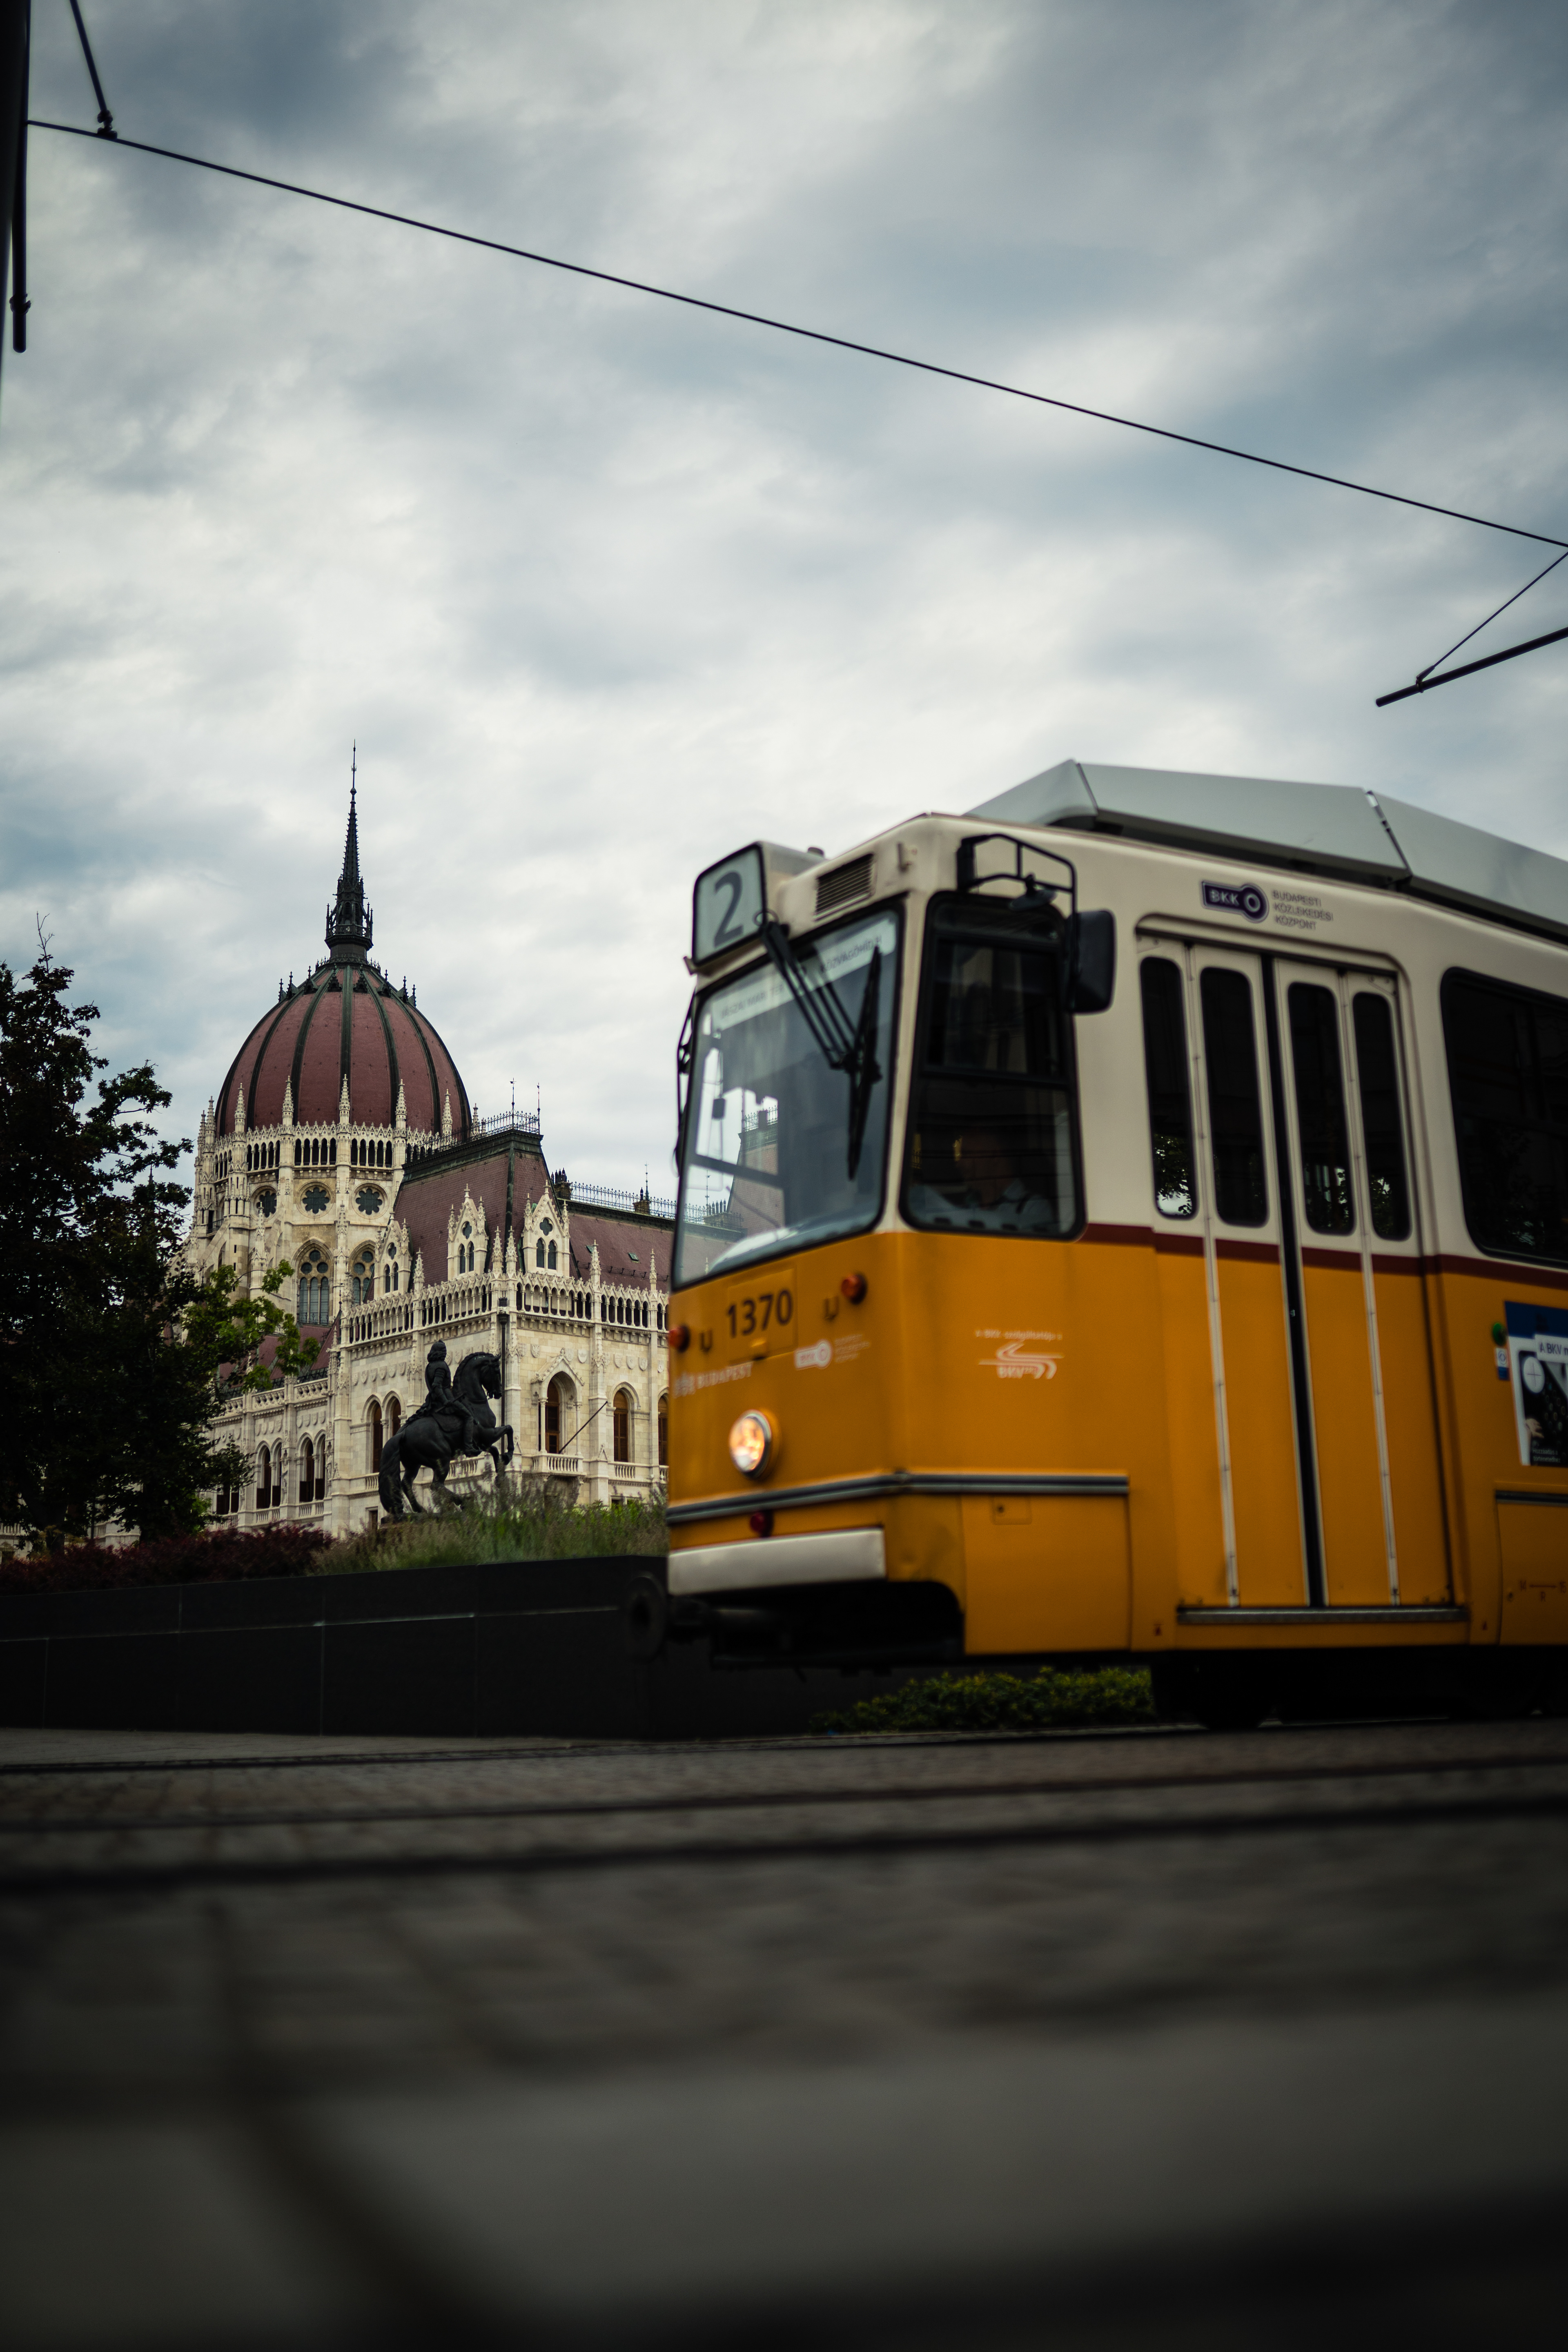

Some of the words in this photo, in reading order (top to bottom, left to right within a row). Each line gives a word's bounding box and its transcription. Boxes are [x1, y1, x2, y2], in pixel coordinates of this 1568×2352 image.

[1210, 889, 1240, 906] BKK
[1272, 890, 1321, 907] BUDAPESTI
[714, 871, 744, 947] 2
[1276, 915, 1316, 929] KÖZPONT
[728, 1290, 793, 1339] 1370
[1539, 1342, 1546, 1353] A
[1546, 1343, 1562, 1355] BKV
[697, 1362, 752, 1389] BUDAPEST
